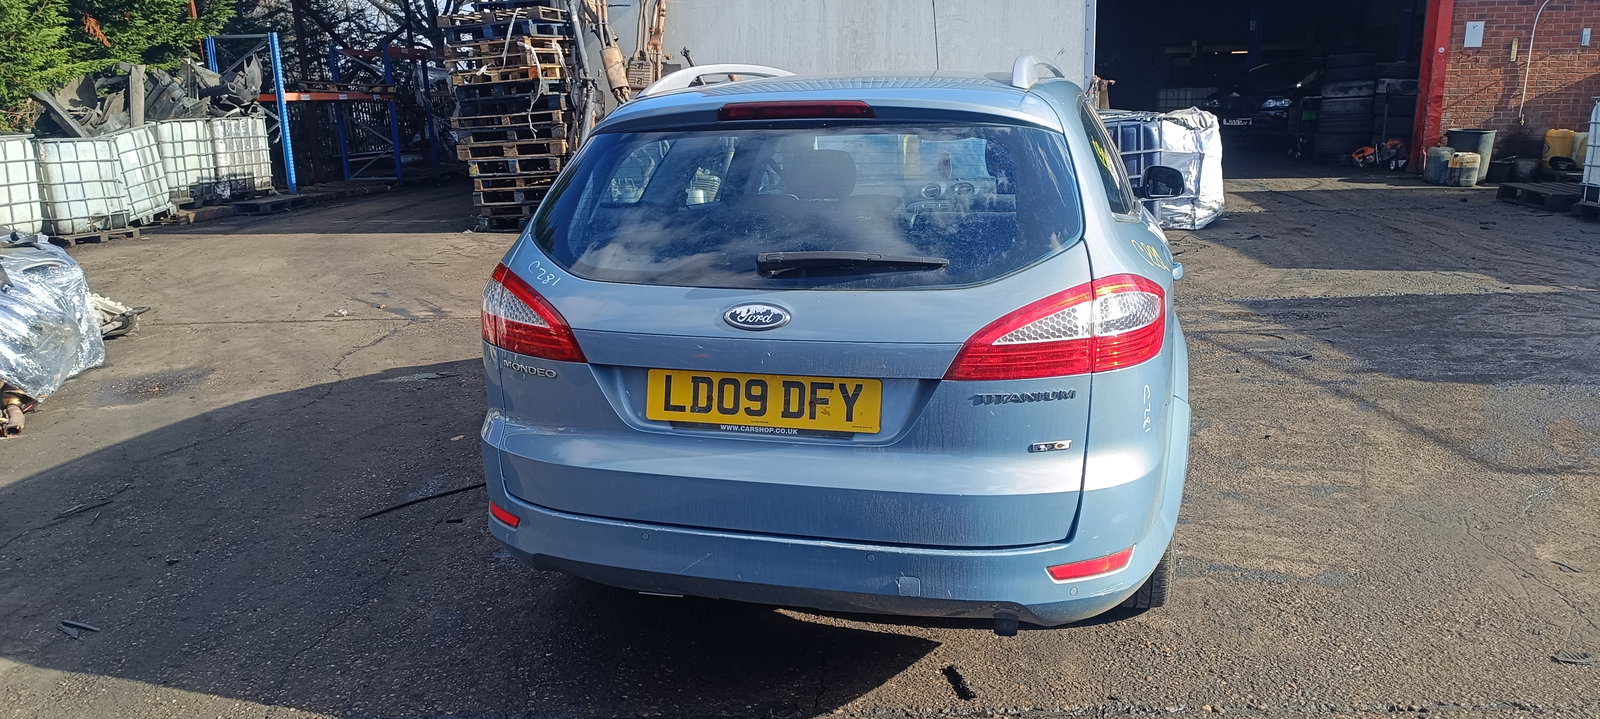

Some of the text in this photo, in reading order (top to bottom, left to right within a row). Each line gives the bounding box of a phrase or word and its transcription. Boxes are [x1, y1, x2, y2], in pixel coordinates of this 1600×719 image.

[528, 260, 562, 287] C281
[738, 307, 773, 323] Ford
[503, 359, 558, 379] MONDEO
[663, 374, 864, 422] LD09 DFY
[970, 388, 1077, 406] TITANIUM
[719, 424, 799, 435] WWW.CARSHOP.CO.UK
